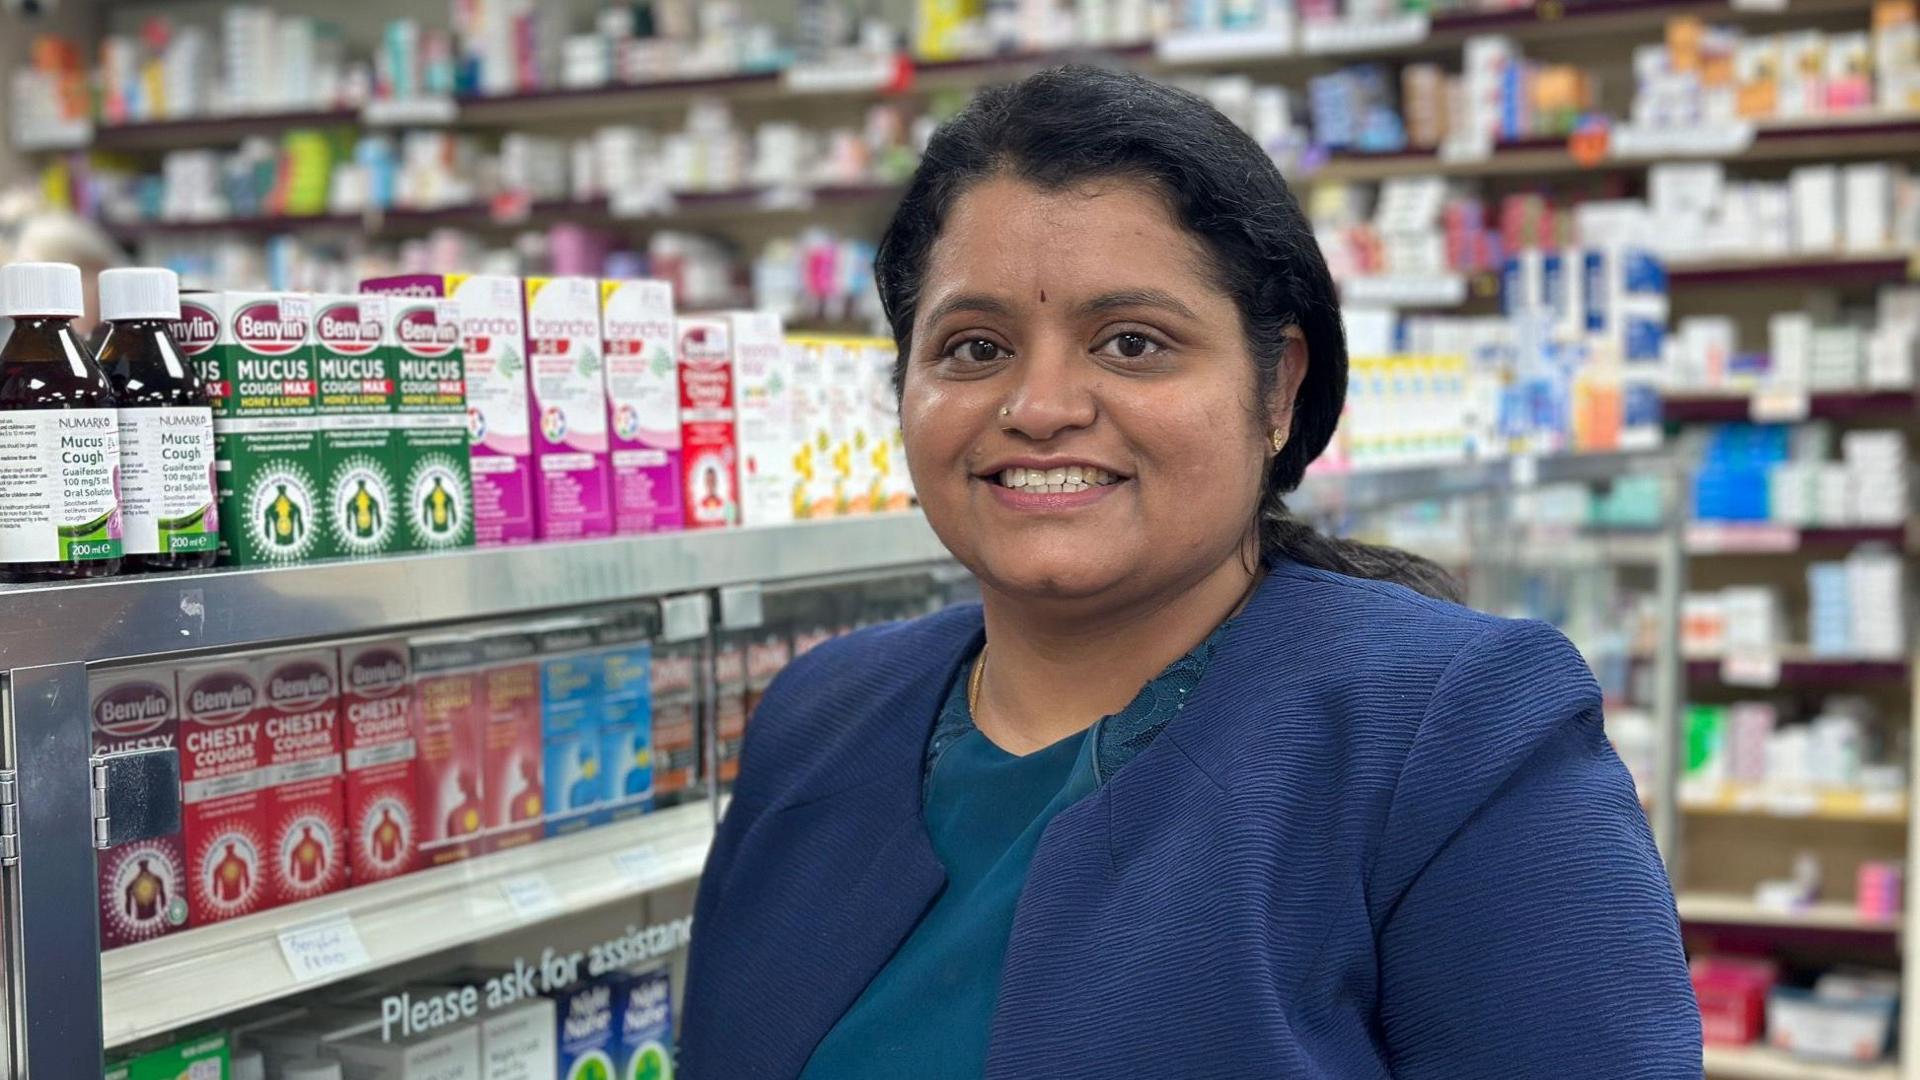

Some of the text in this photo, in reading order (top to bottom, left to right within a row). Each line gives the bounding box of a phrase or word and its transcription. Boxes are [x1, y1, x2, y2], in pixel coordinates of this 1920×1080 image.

[173, 316, 215, 341] nylin
[240, 316, 304, 341] Benylin
[322, 317, 380, 343] Benylin
[401, 319, 458, 343] Benylin
[463, 317, 518, 335] roncho
[237, 360, 309, 380] MUCUS
[320, 360, 384, 379] MUCUS
[399, 360, 461, 380] MUCUS
[205, 382, 222, 396] AX
[239, 381, 312, 396] COUGH MAX
[321, 380, 387, 394] COUGH MAX
[400, 380, 464, 395] COUGH MAX
[241, 397, 272, 408] HONEY
[281, 396, 311, 407] LEMON
[59, 417, 104, 428] NUMARK
[160, 415, 201, 426] NUMARK
[61, 436, 103, 448] Mucus
[161, 433, 200, 445] Mucus
[62, 451, 104, 465] Cough
[162, 448, 201, 461] Cough
[164, 473, 180, 481] 100
[63, 488, 112, 497] Oral Solution
[164, 484, 182, 492] Oral
[72, 544, 91, 555] 200
[171, 537, 188, 547] 200
[352, 659, 405, 687] Benylin
[271, 672, 330, 699] Benylin
[192, 684, 254, 713] Benylin
[101, 694, 167, 723] Benylin
[347, 696, 411, 723] CHESTY
[264, 710, 337, 738] CHESTY
[186, 721, 260, 753] CHESTY
[273, 730, 332, 752] COUGHS
[194, 743, 256, 768] COUGHS
[382, 984, 478, 1043] Please
[485, 956, 537, 1010] ask
[540, 945, 585, 992] for
